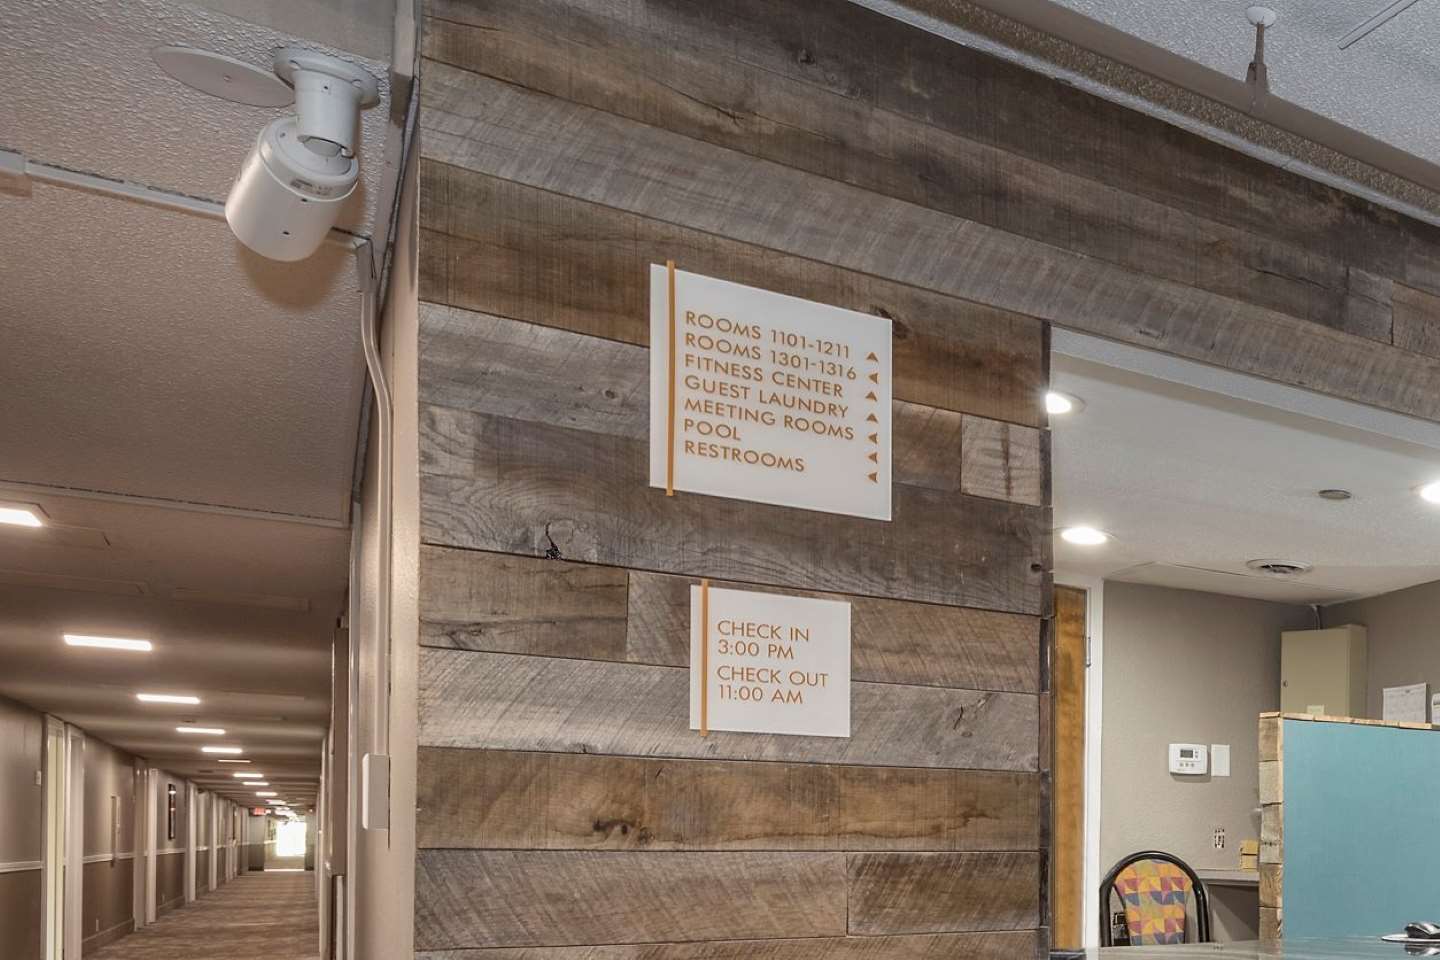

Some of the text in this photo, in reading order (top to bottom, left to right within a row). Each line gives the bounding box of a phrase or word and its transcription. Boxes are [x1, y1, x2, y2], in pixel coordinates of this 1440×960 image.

[686, 311, 849, 359] ROOMS 1101-1211
[685, 332, 857, 381] ROOMS 1301-1316
[685, 354, 843, 397] FITNESS CENTER
[684, 374, 849, 418] GUEST LAUNDRY
[684, 398, 855, 440] MEETING ROOMS
[684, 418, 742, 441] POOL
[684, 440, 805, 472] RESTROOMS
[717, 620, 809, 642] CHECK IN
[717, 639, 794, 660] 3:00 PM
[717, 665, 829, 687] CHECK OUT
[719, 684, 803, 704] 11:00 AM
